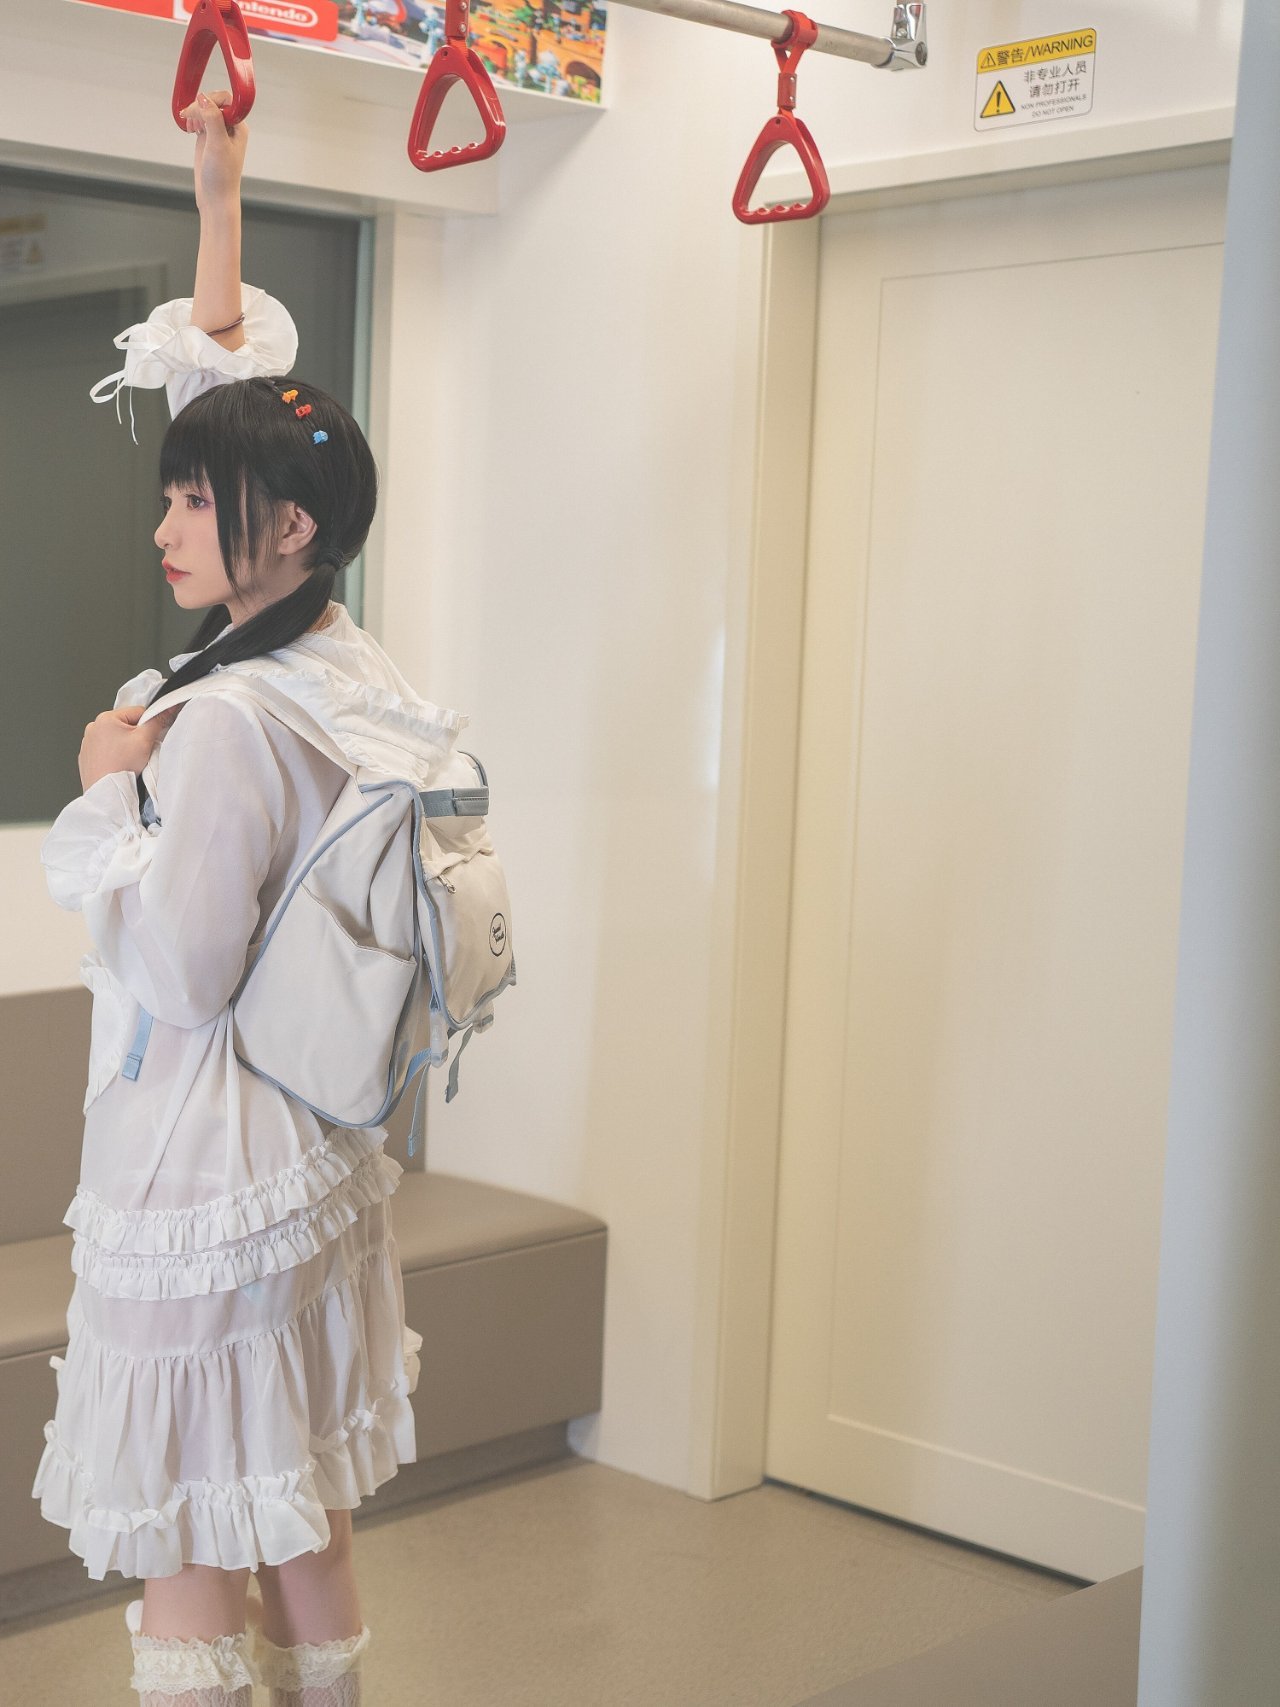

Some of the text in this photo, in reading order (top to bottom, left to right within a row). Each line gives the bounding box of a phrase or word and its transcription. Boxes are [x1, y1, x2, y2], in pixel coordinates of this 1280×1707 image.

[241, 1, 308, 22] ntendo
[1024, 60, 1087, 83] 非专业人员
[1030, 78, 1080, 98] 请勿打开
